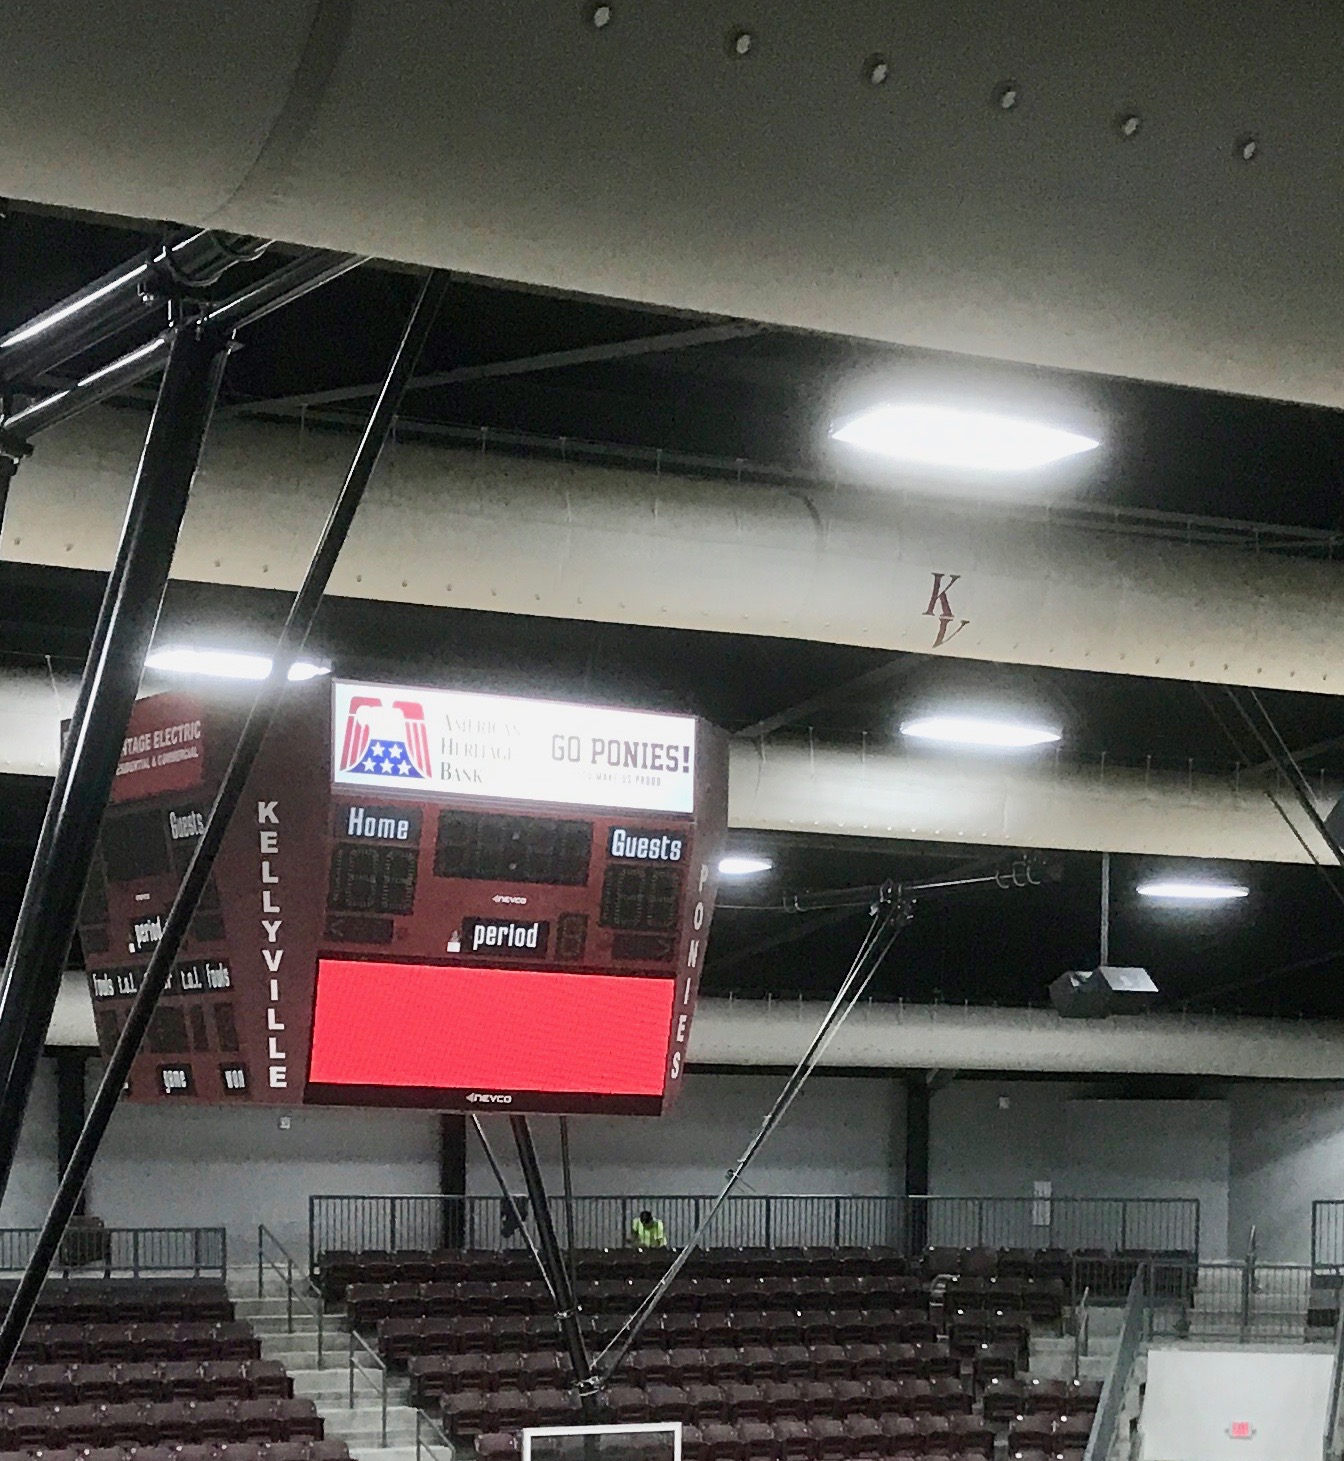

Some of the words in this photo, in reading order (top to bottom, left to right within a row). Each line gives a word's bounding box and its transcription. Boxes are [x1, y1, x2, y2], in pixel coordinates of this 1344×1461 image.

[153, 720, 202, 749] ELECTRIC
[551, 734, 581, 763] GO
[591, 737, 690, 774] PONIES!
[440, 761, 483, 784] BANK
[169, 810, 206, 840] Guests
[347, 807, 410, 840] Home
[611, 829, 682, 861] Guests
[257, 800, 288, 1089] KELLYVILLE
[472, 922, 539, 950] period
